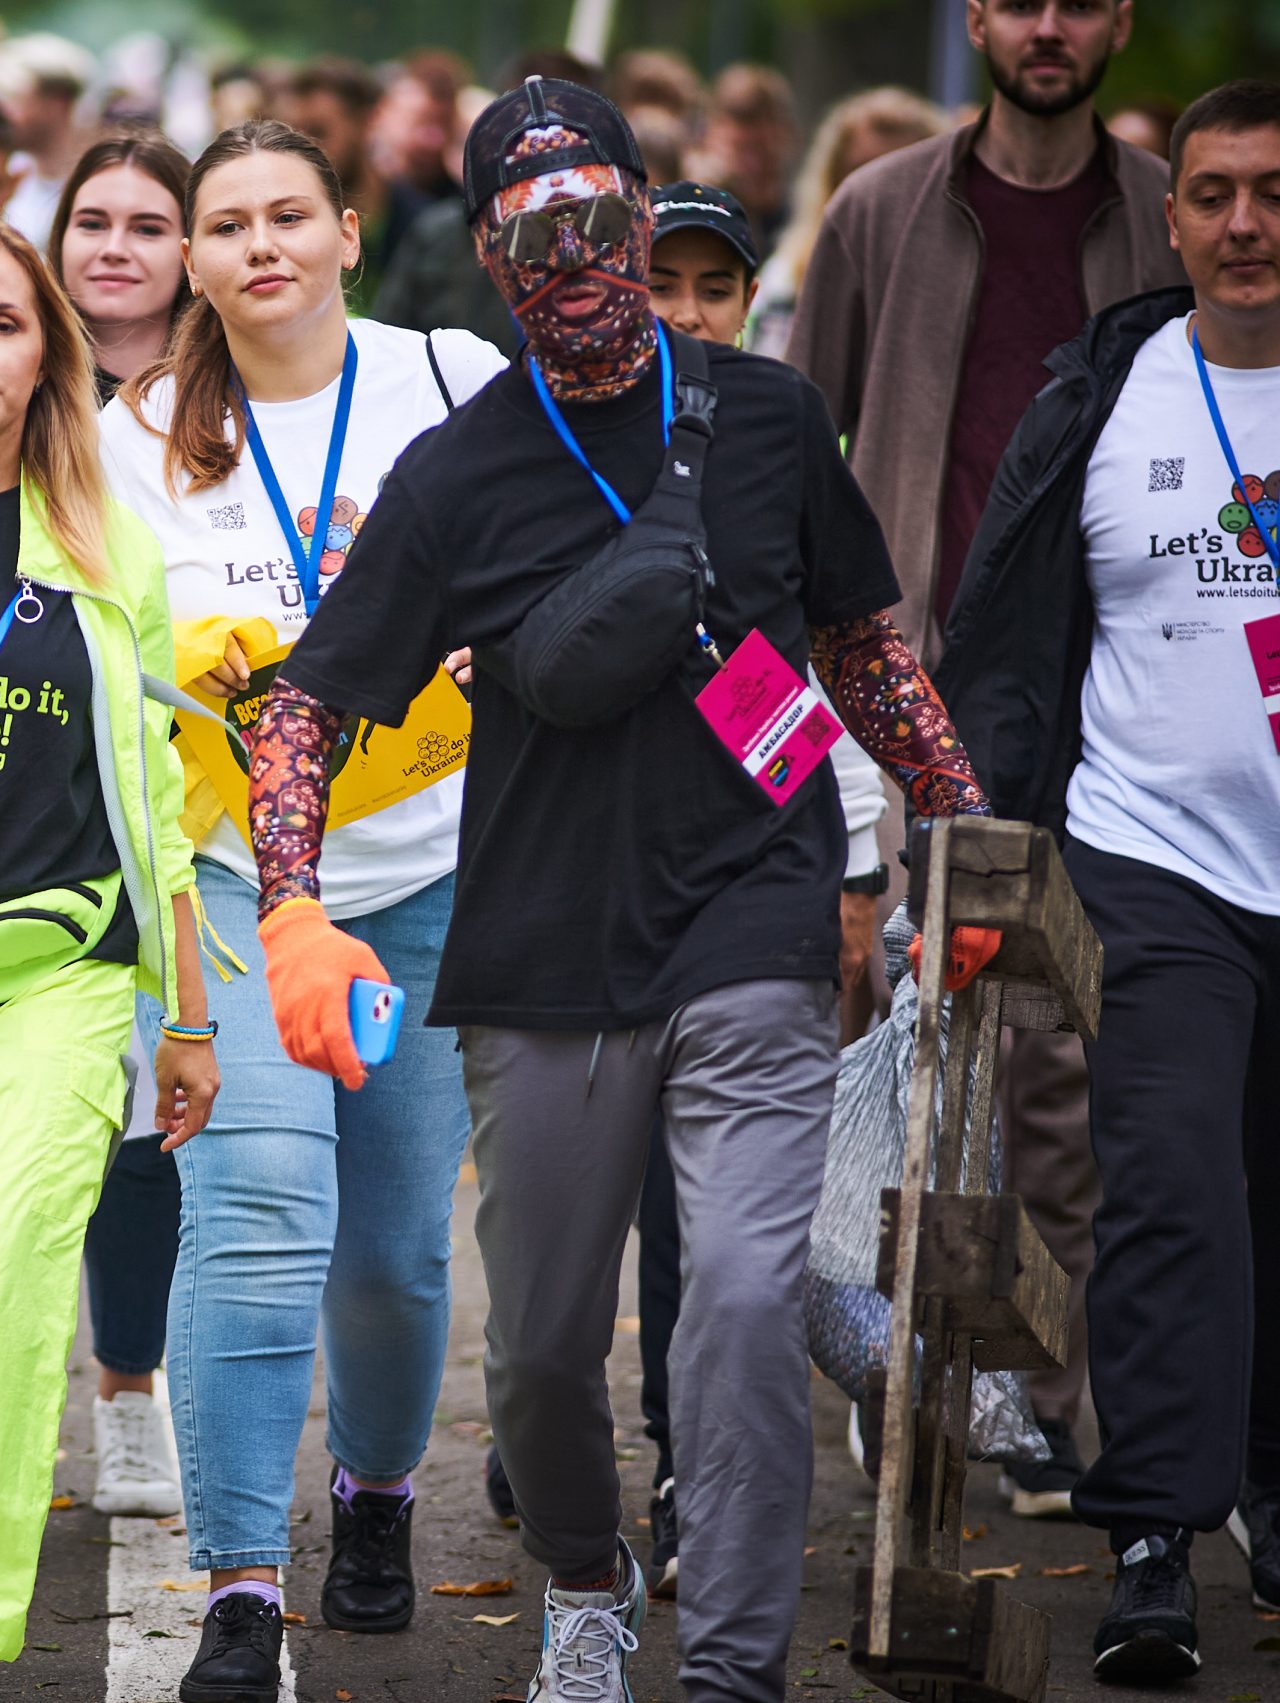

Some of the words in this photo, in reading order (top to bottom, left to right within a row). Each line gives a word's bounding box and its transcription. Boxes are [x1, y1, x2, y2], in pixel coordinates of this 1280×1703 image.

[1149, 528, 1224, 558] Let's
[36, 680, 70, 726] it,
[757, 704, 805, 760] АМБАСАДОР
[402, 759, 428, 777] Let's
[450, 740, 464, 751] do
[420, 747, 467, 778] Ukraine!
